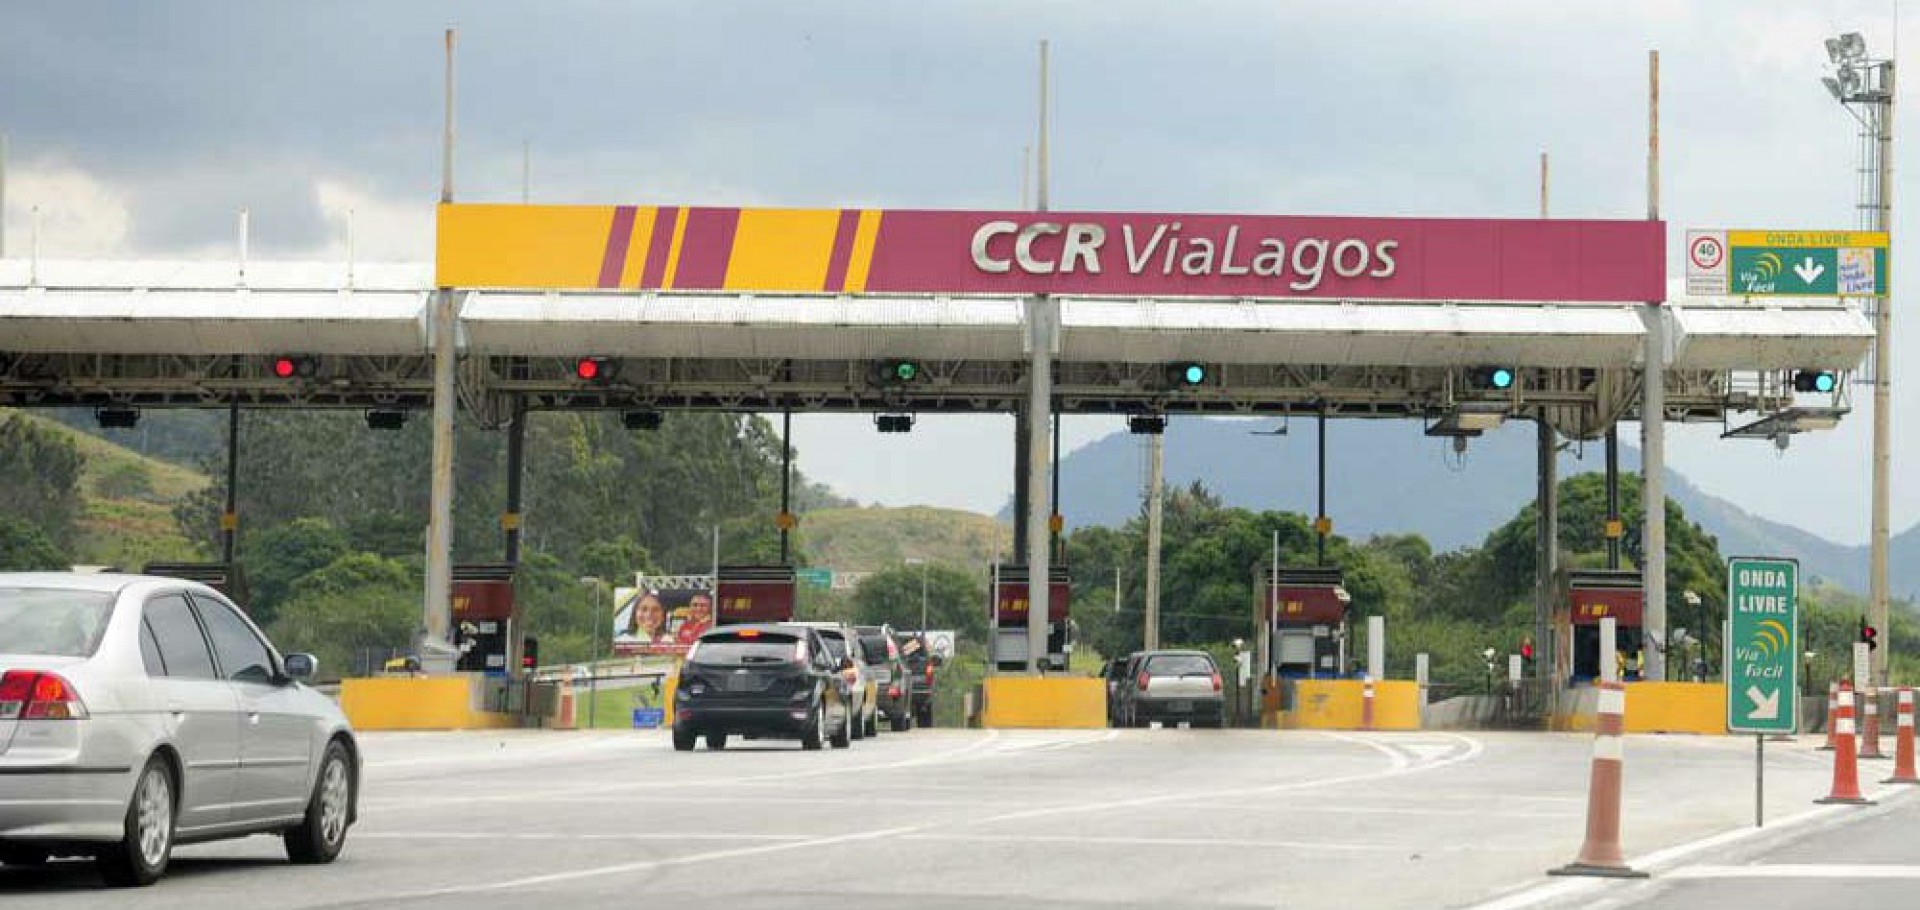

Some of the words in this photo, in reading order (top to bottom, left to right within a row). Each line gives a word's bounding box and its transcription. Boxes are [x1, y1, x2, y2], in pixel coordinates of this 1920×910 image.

[1766, 233, 1804, 245] ONDA
[1810, 233, 1850, 245] LIVRE
[970, 220, 1105, 274] CCR
[1121, 221, 1399, 291] ViaLagos
[1699, 243, 1715, 256] 40
[1739, 570, 1786, 588] ONDA
[1739, 595, 1787, 613] LIVRE
